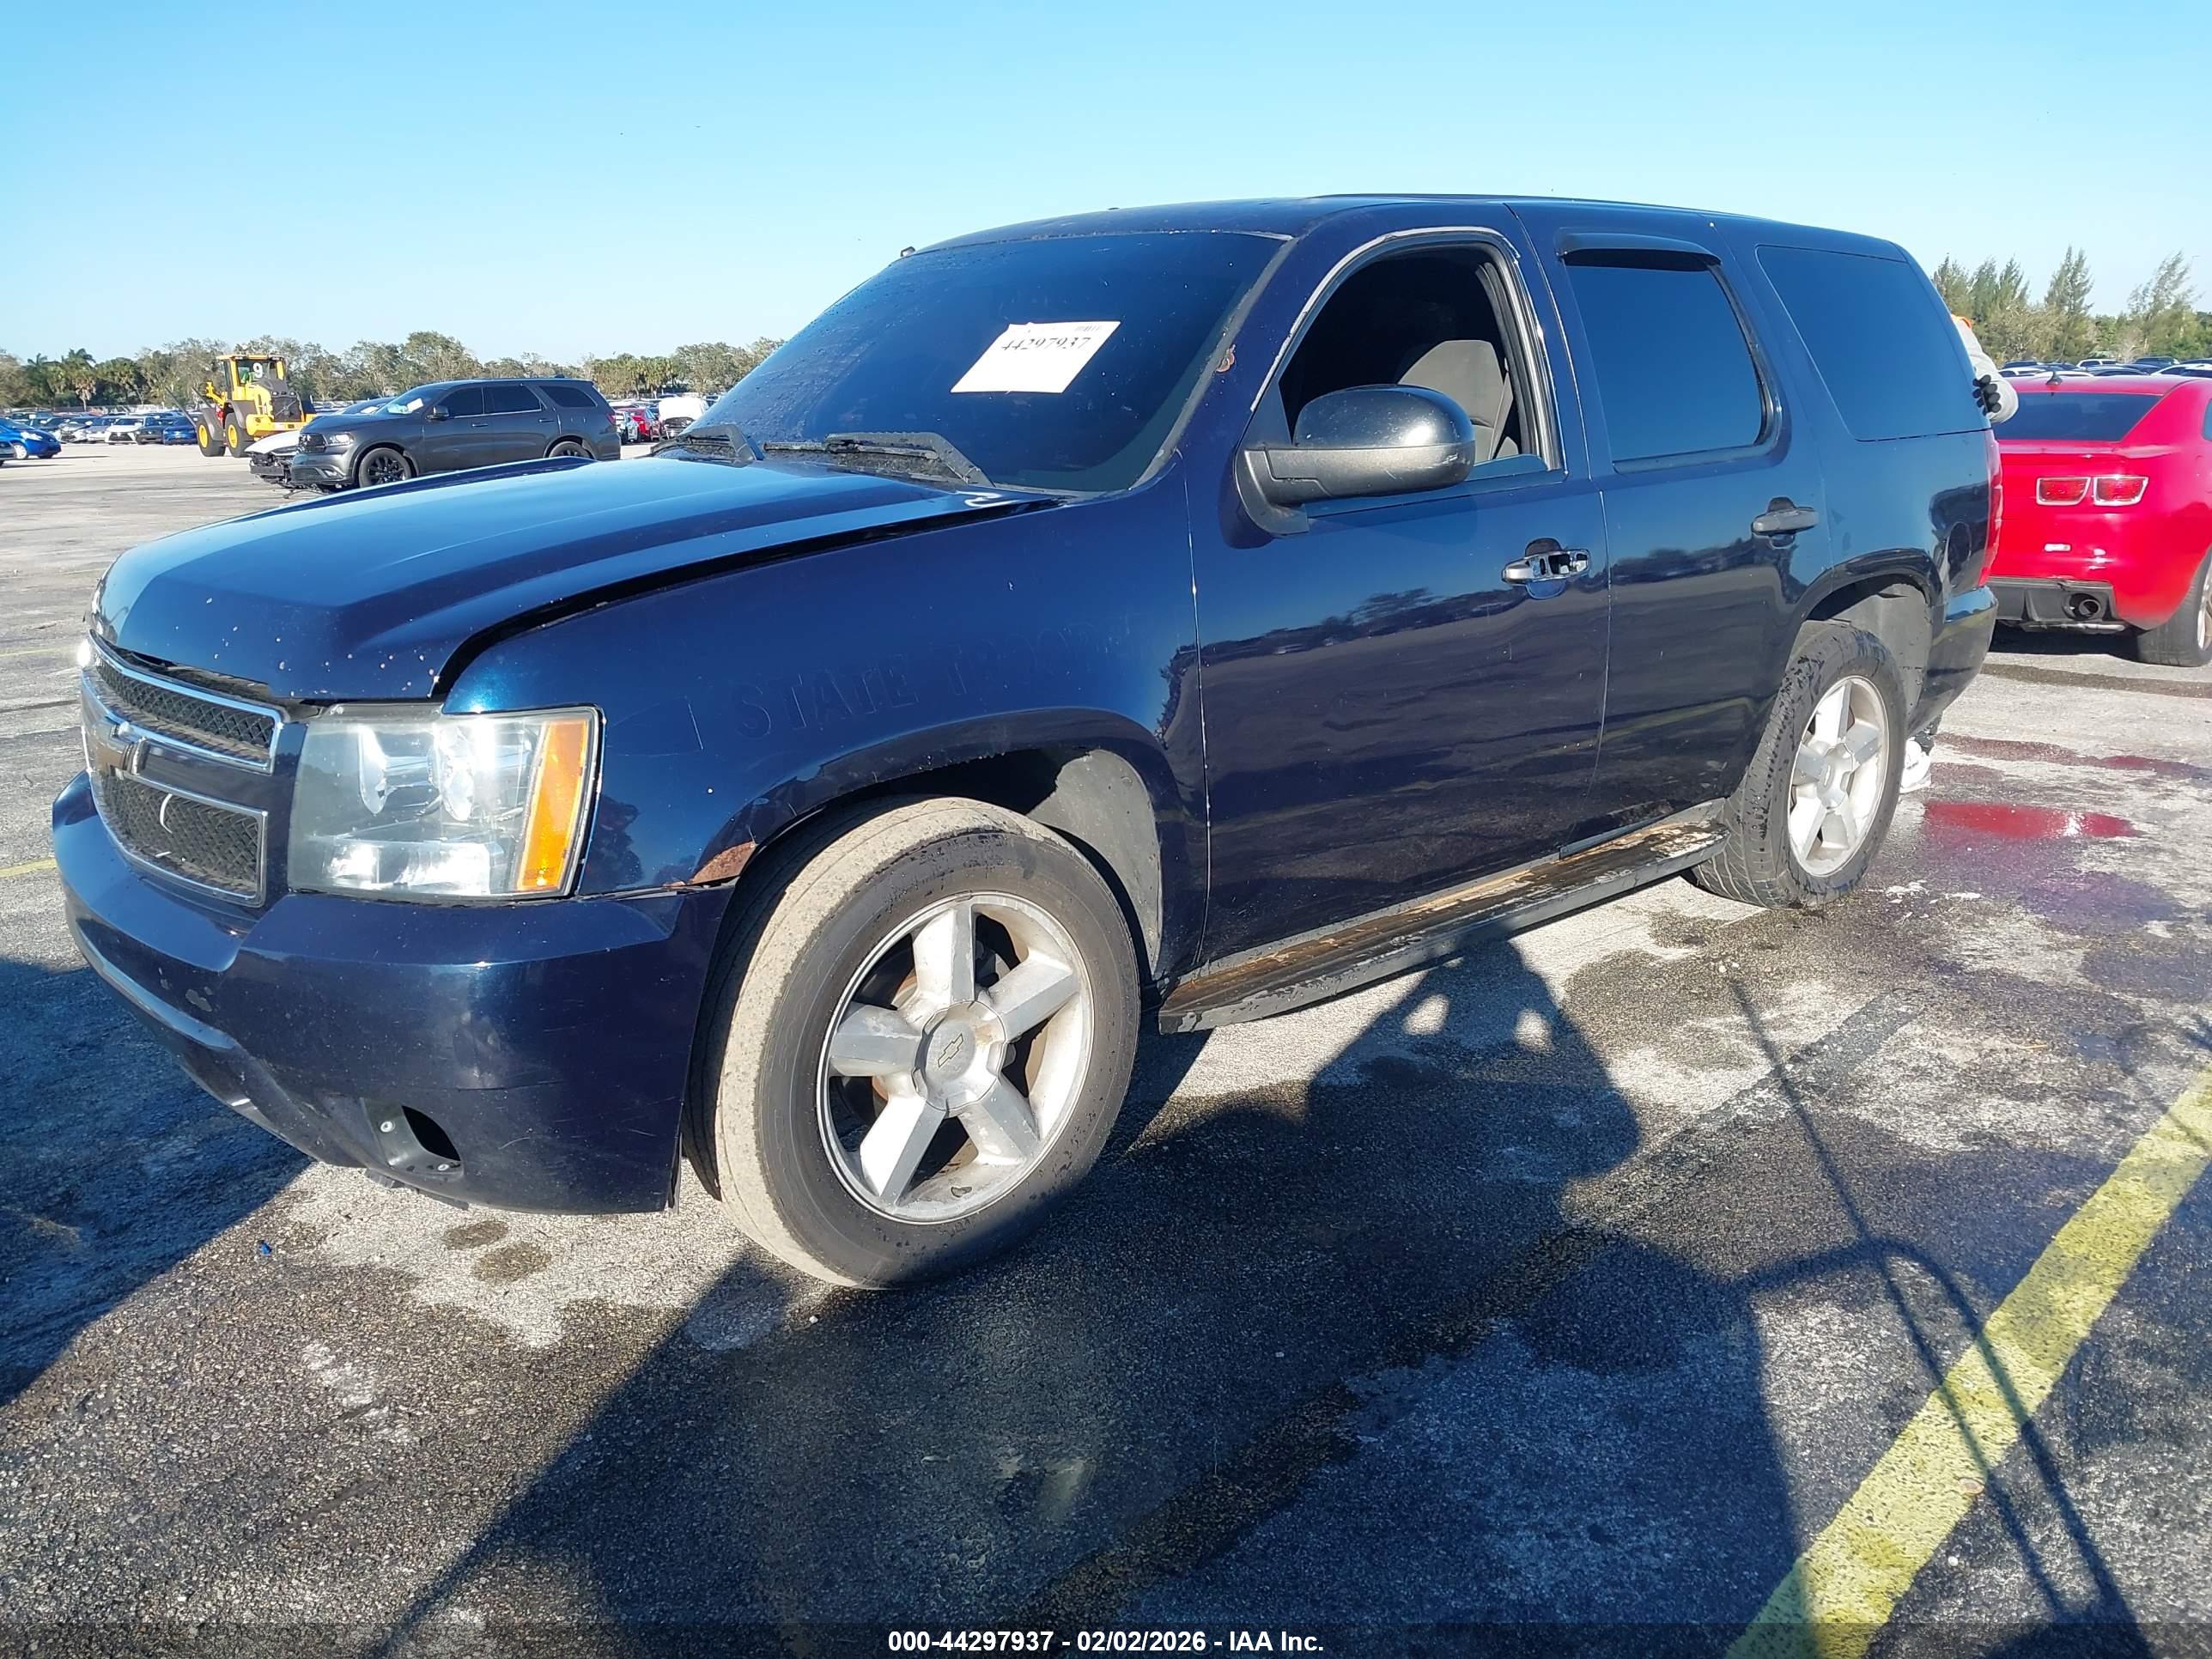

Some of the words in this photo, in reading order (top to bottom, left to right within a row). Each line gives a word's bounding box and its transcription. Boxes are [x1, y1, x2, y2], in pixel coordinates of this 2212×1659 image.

[1001, 337, 1092, 351] 44297937
[252, 362, 264, 379] 9
[730, 651, 920, 739] STATE
